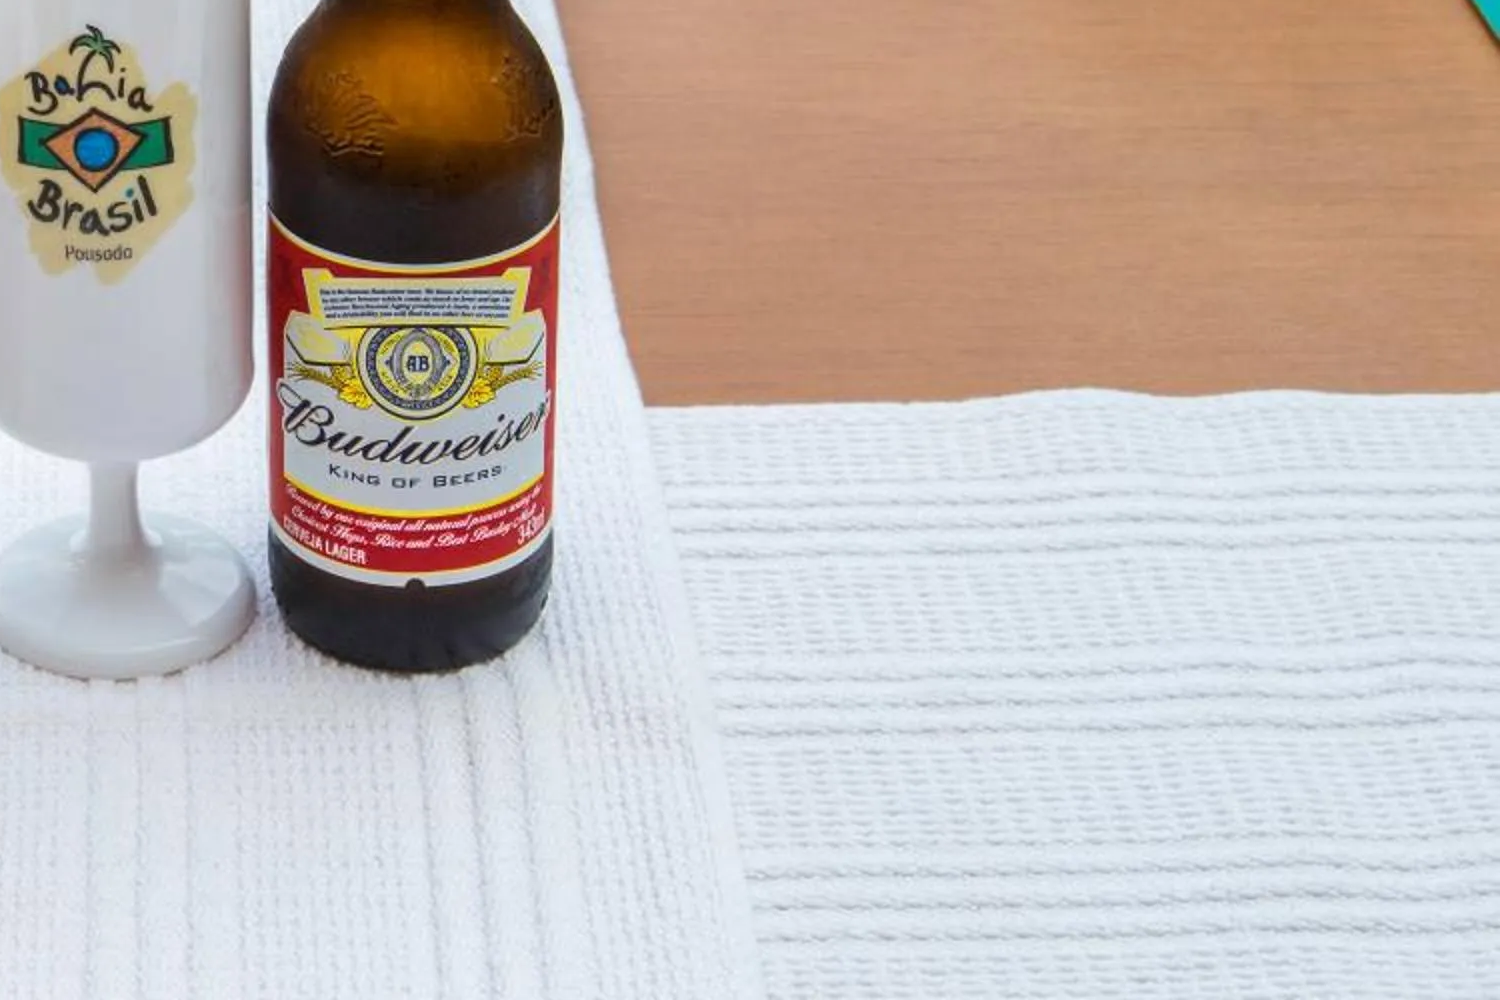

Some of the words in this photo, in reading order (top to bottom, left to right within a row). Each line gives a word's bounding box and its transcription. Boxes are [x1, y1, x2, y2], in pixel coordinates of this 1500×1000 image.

[24, 24, 154, 116] Bahia
[28, 174, 159, 237] Brasil
[65, 245, 134, 262] Pousada
[278, 383, 548, 465] Budweiser
[328, 463, 382, 486] KING
[391, 477, 422, 489] OF
[433, 465, 502, 488] BEERS
[355, 518, 406, 532] original
[325, 540, 367, 565] LAGER
[370, 533, 405, 549] Rice
[405, 535, 435, 549] and
